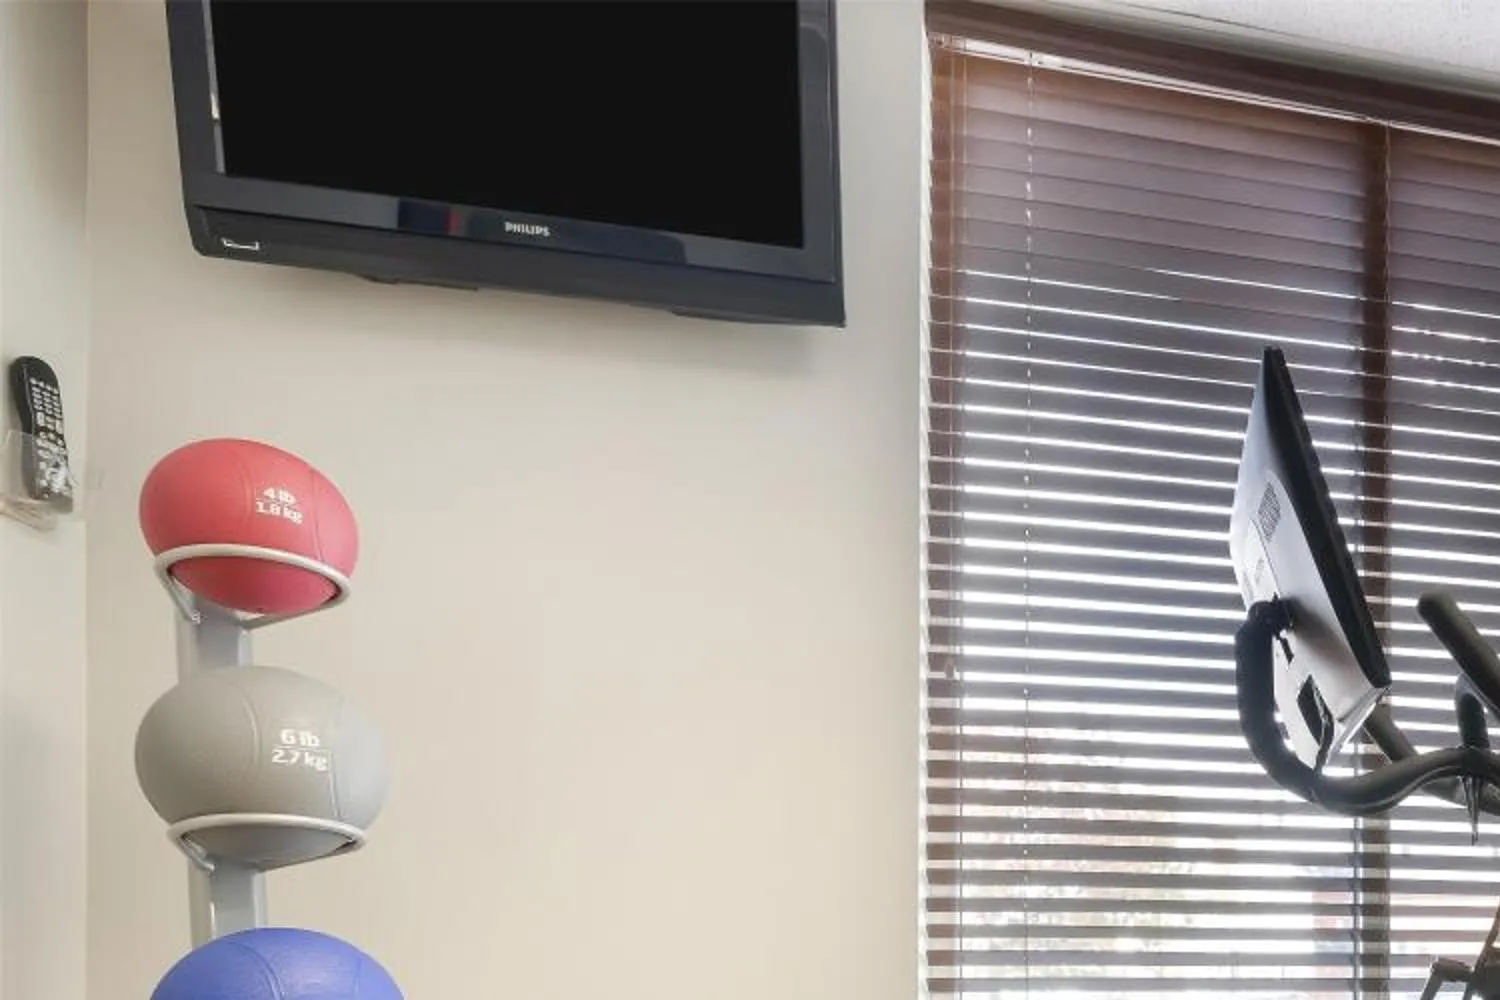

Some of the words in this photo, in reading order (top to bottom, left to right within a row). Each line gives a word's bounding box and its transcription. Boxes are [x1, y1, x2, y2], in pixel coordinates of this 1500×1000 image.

[504, 221, 550, 237] PHILIPS
[263, 487, 275, 500] 4
[279, 489, 297, 504] lb
[283, 505, 303, 525] kg
[299, 730, 321, 748] lb
[304, 751, 328, 772] kg
